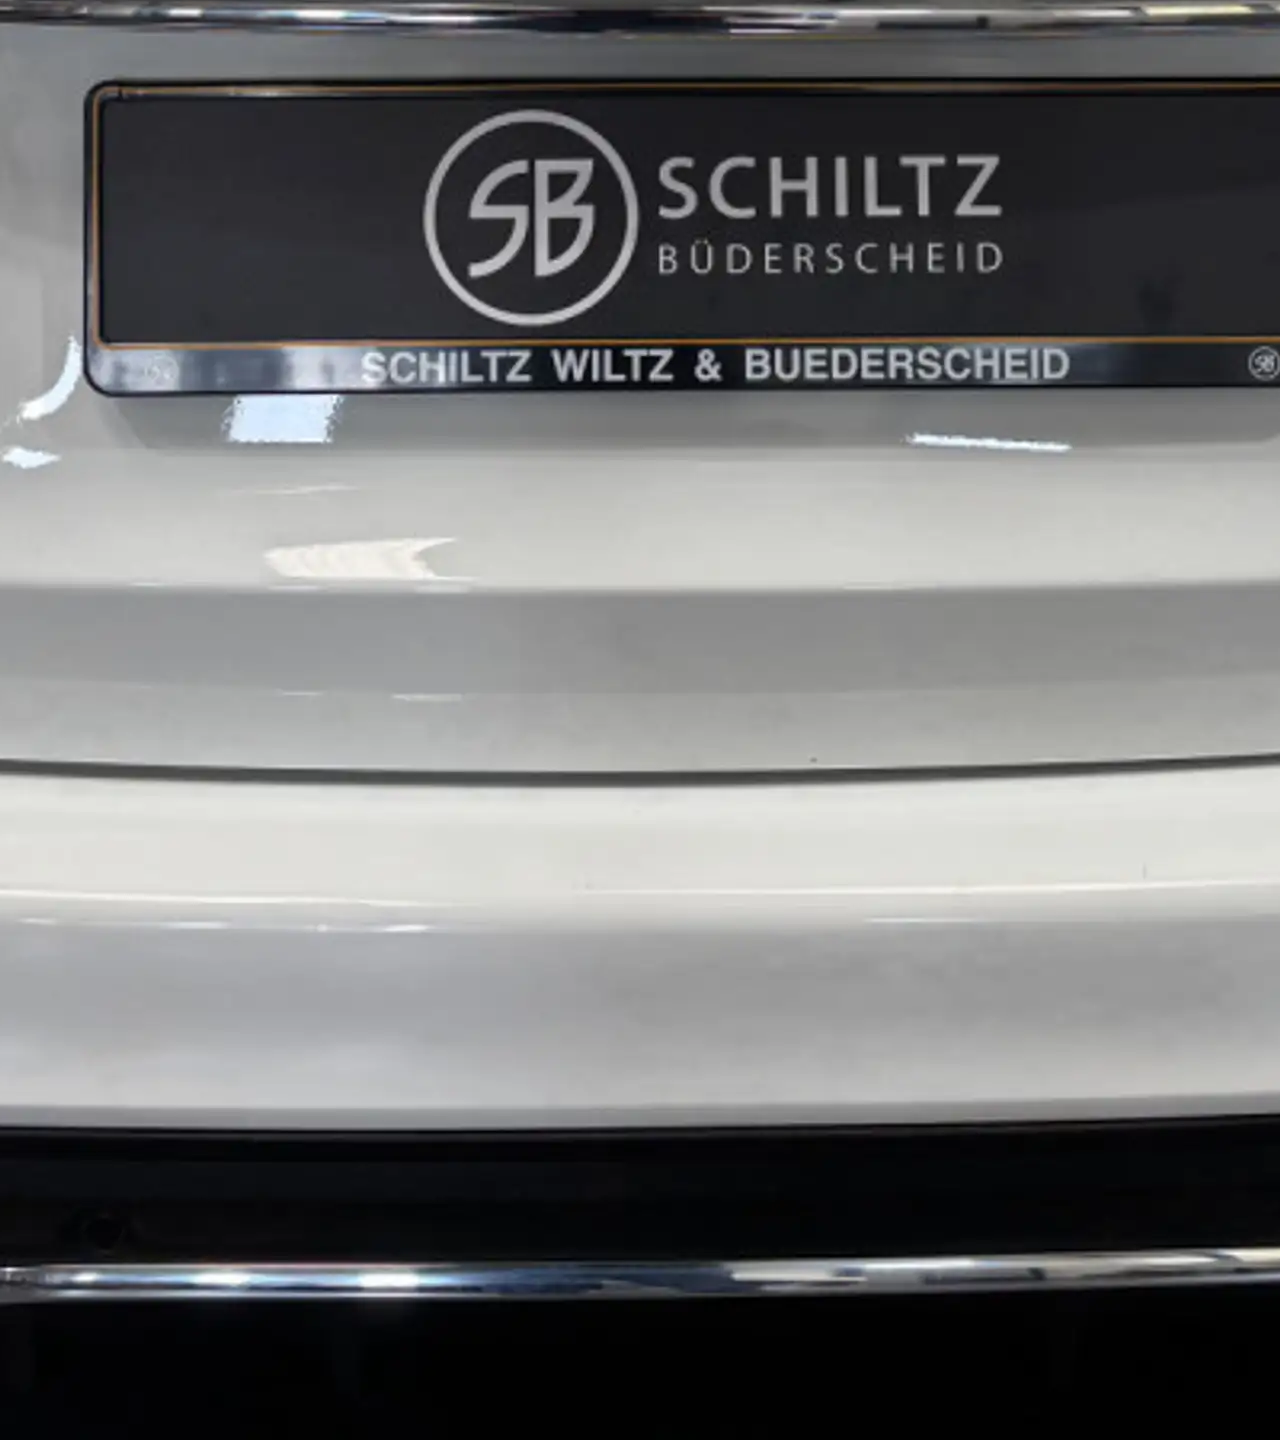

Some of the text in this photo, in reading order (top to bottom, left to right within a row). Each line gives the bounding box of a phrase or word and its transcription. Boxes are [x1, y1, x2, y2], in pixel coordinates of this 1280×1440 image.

[657, 155, 1004, 219] SCHILTZ
[657, 238, 1004, 275] BÜDERSCHEID
[361, 346, 1071, 386] SCHILTZ WILTZ & BUEDERSCHEID
